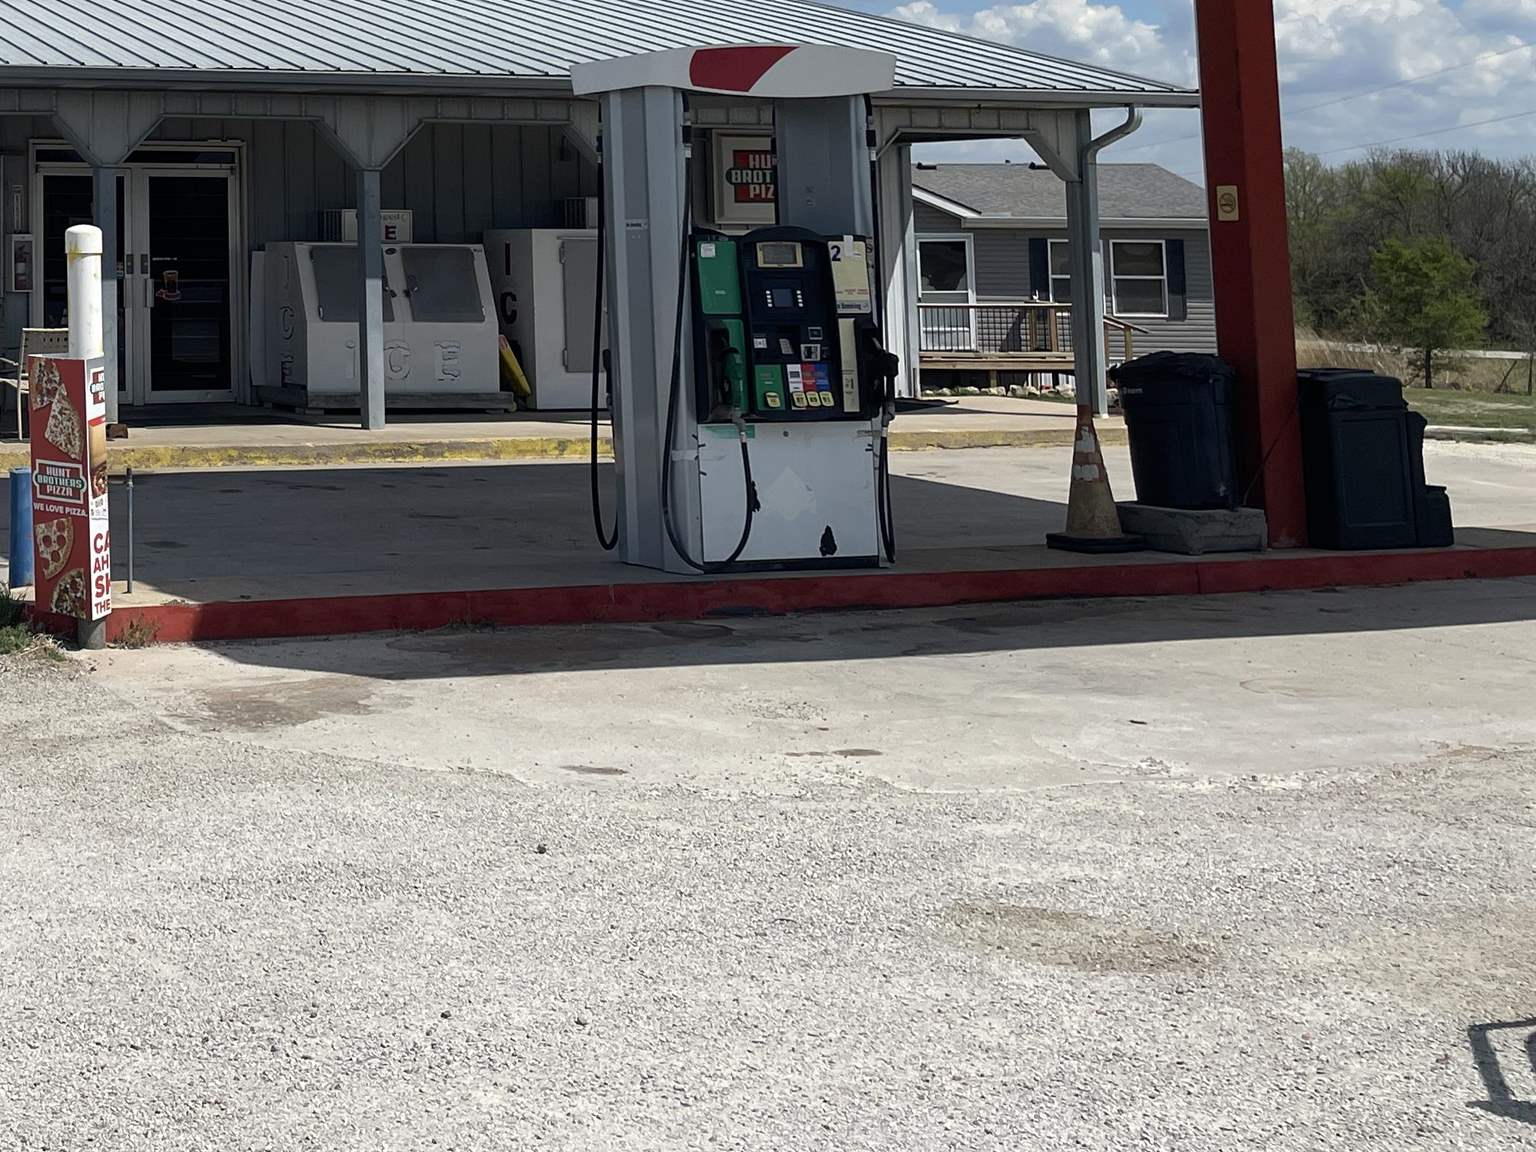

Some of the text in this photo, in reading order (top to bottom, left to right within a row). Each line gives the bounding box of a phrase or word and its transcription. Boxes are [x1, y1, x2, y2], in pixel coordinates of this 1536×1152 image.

[748, 153, 778, 169] HU
[731, 169, 773, 184] BROT
[749, 184, 775, 199] PIZ
[830, 245, 841, 262] 2
[46, 466, 71, 478] HUNT
[37, 474, 82, 489] BROTHERS
[46, 485, 73, 497] PIZZA
[33, 502, 44, 511] WE
[45, 504, 64, 514] LOVE
[93, 530, 111, 554] CA
[93, 554, 109, 574] AH
